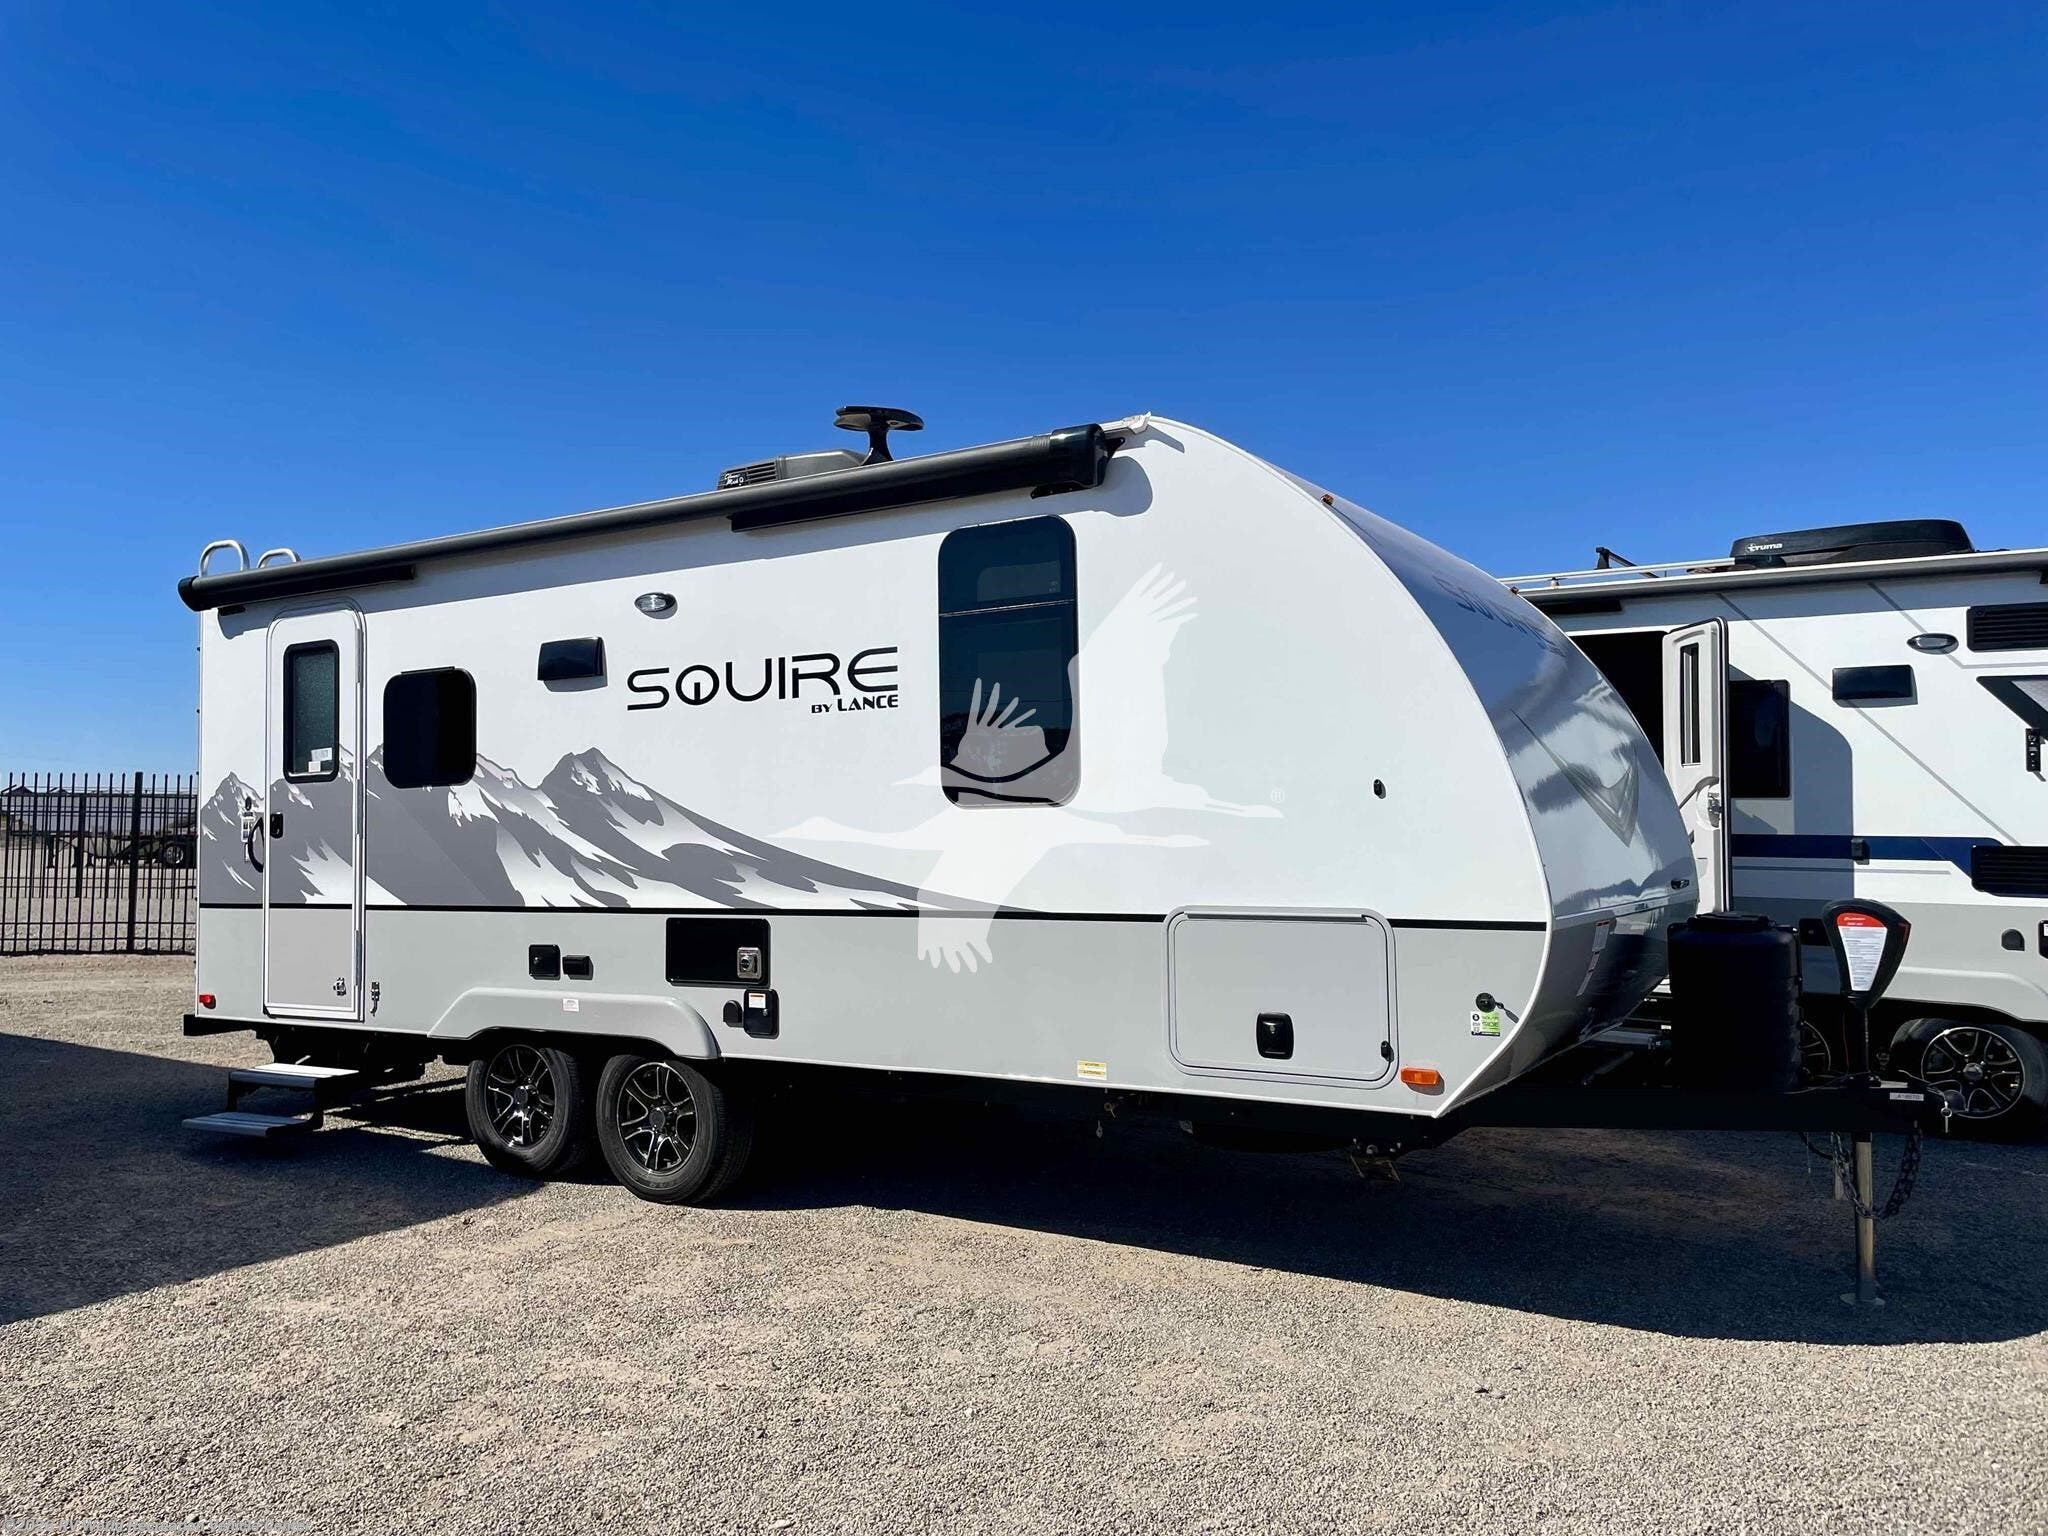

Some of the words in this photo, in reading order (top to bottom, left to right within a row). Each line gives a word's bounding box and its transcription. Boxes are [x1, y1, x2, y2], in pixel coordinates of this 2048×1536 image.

[1747, 543, 1783, 552] truma
[626, 646, 898, 711] SQUIRE
[811, 703, 833, 714] BY
[837, 694, 898, 712] LANCE
